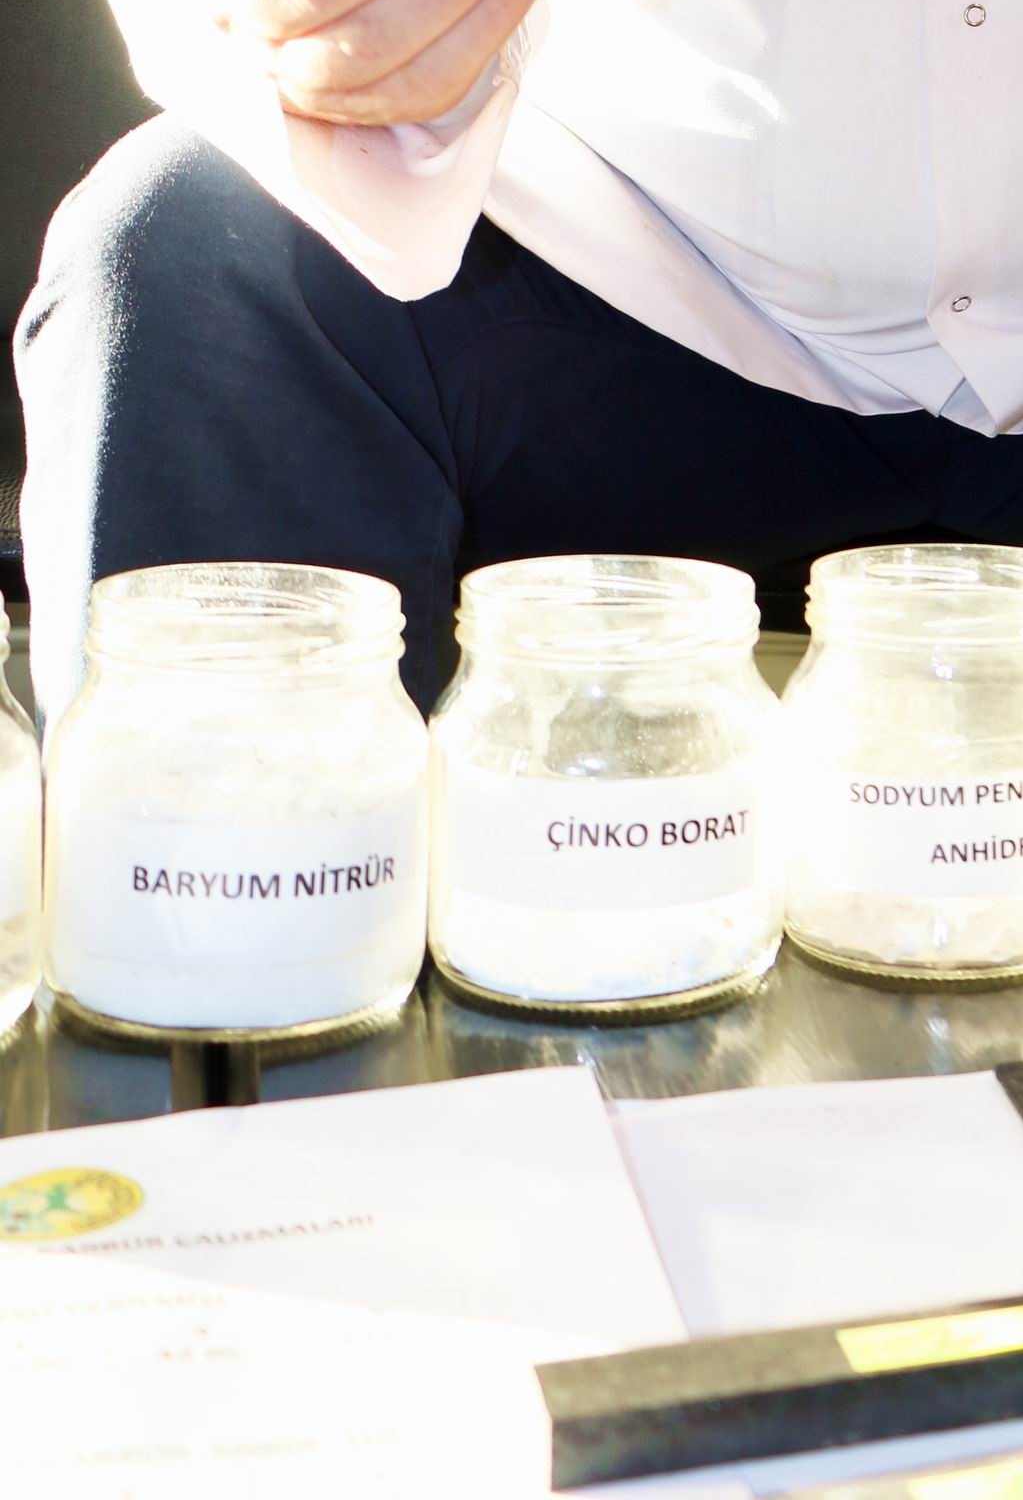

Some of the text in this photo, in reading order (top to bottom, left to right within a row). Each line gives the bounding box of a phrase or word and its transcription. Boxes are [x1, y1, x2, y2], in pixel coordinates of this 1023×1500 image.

[850, 783, 964, 807] SODYUM
[548, 810, 749, 852] ÇİNKO BORAT
[132, 854, 396, 899] BARYUM NİTRÜR
